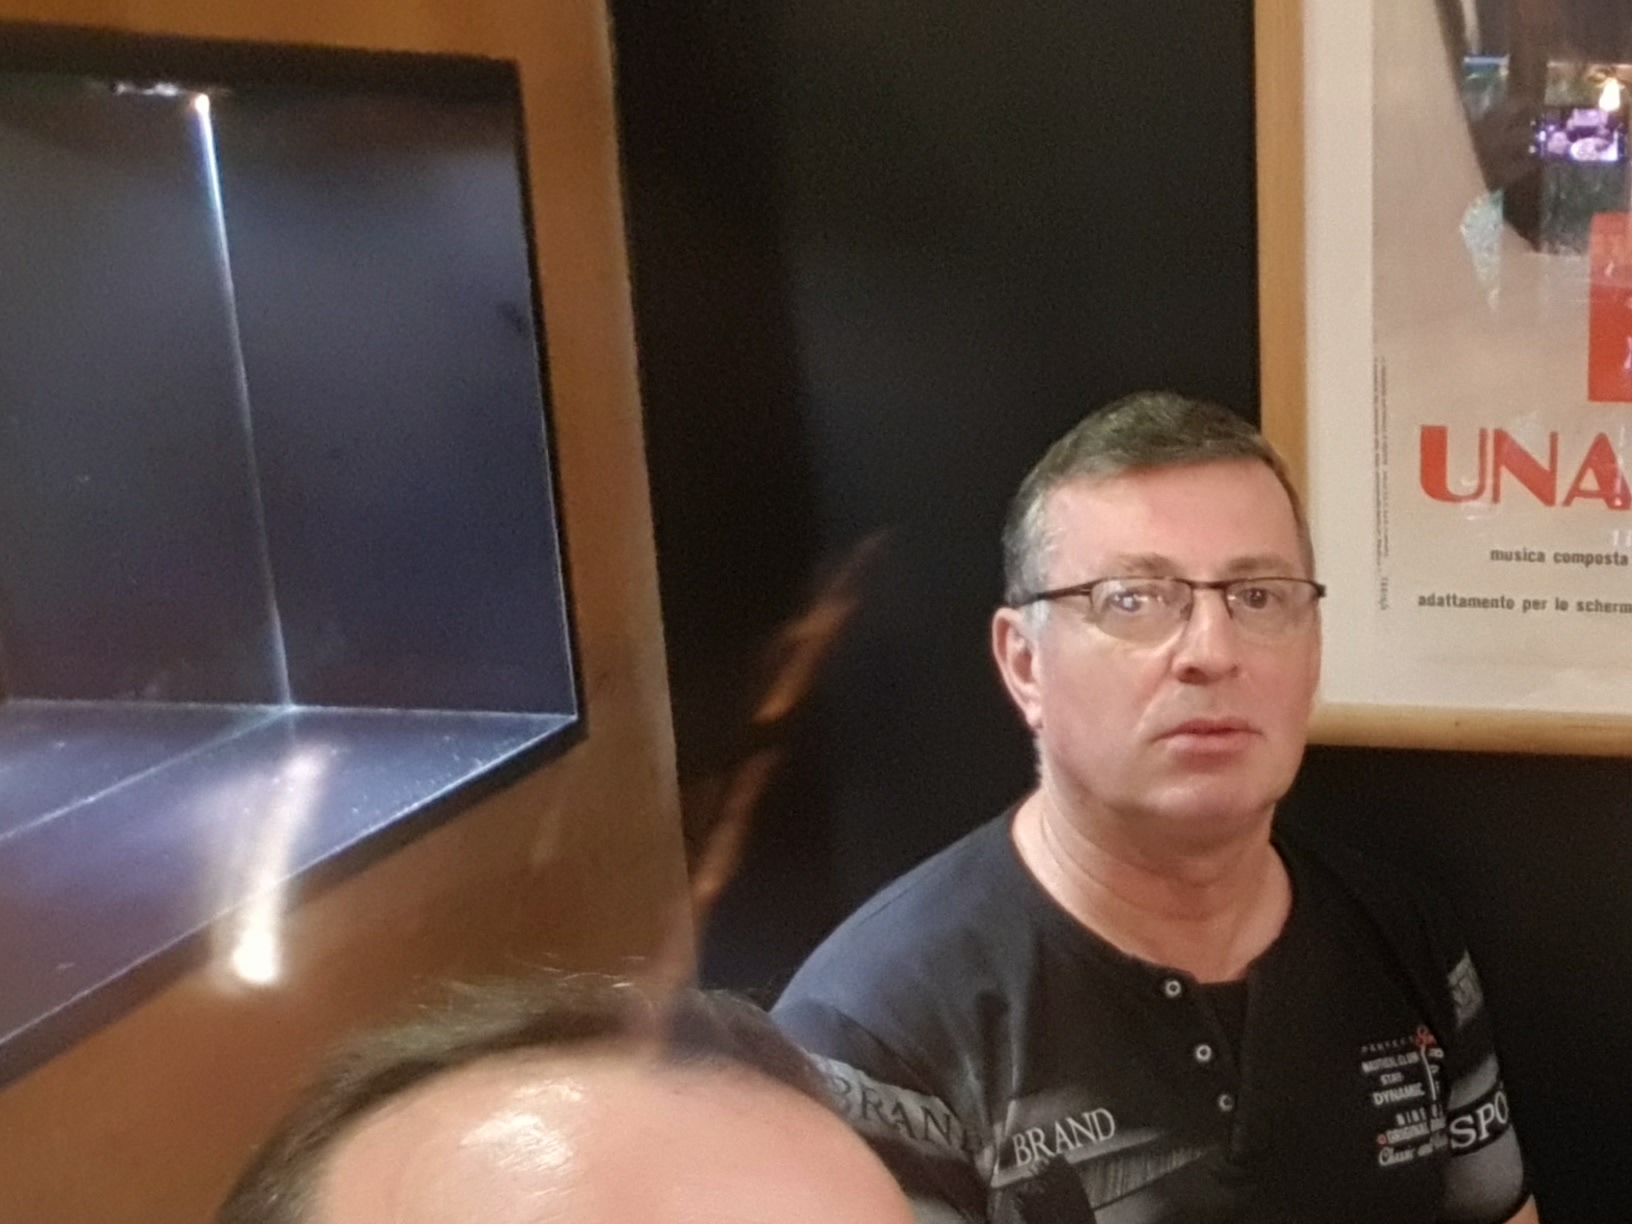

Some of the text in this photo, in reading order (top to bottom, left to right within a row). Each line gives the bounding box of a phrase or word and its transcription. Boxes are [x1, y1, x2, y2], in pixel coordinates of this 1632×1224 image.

[1490, 548, 1546, 563] musica
[1553, 551, 1629, 568] composta
[1418, 593, 1515, 610] adattamento
[1523, 598, 1548, 613] per
[1012, 1107, 1117, 1168] BRAND
